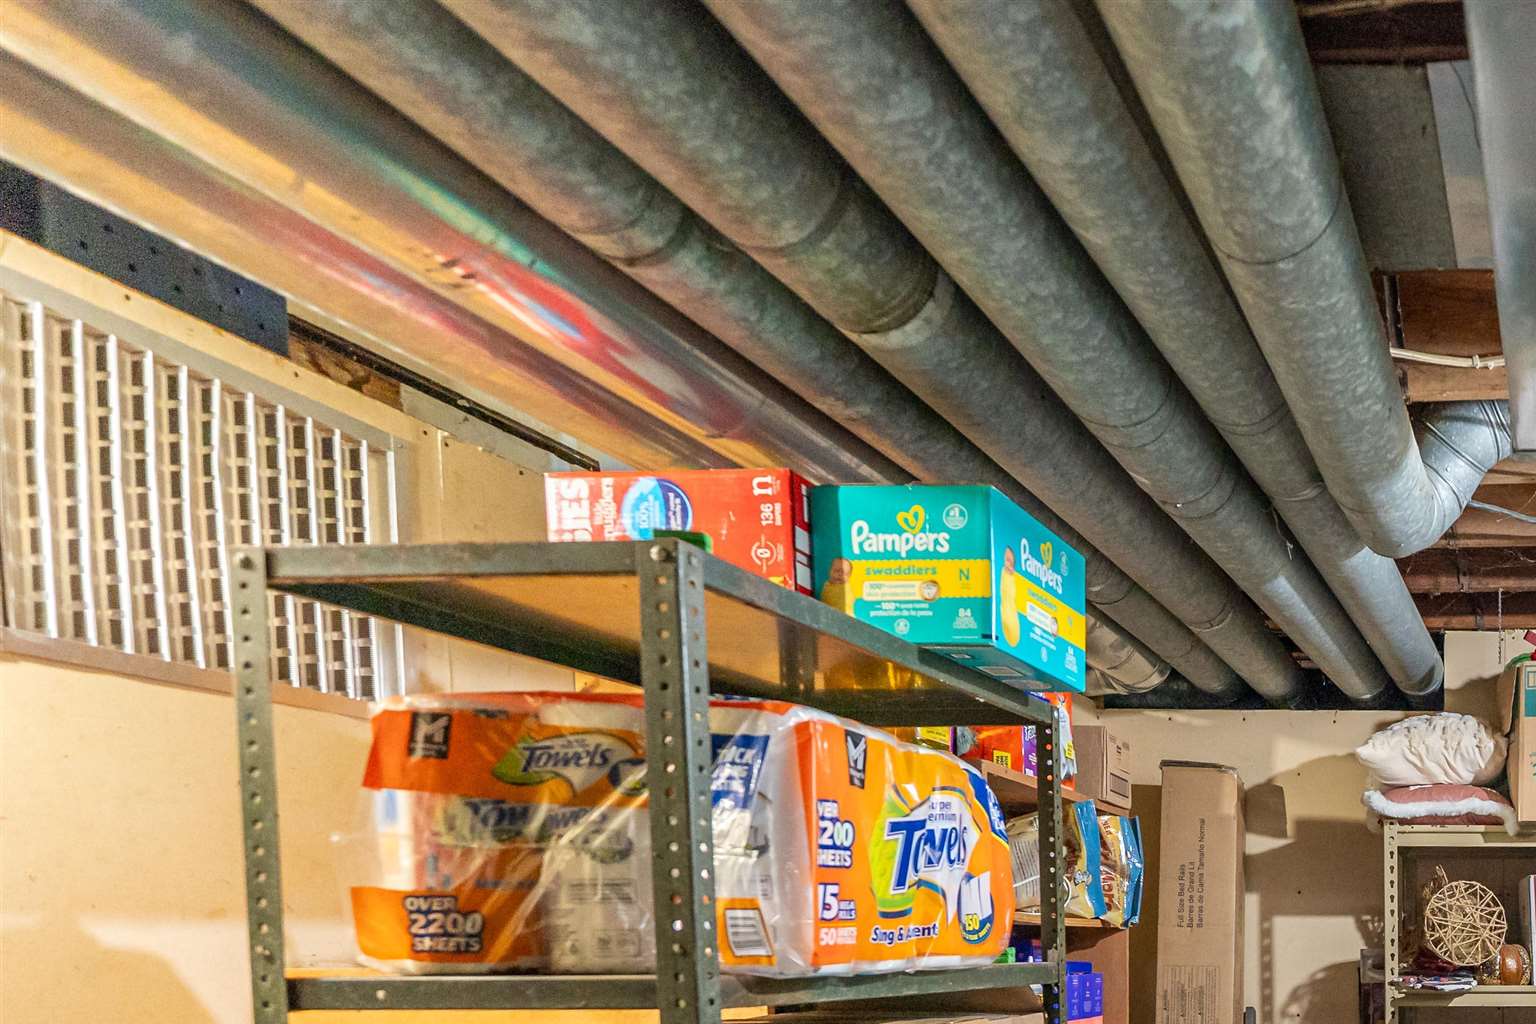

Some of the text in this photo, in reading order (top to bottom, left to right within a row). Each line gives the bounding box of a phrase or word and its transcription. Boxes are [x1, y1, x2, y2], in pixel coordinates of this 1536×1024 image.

[760, 503, 773, 527] 136
[851, 520, 950, 558] Pampers
[865, 565, 937, 576] swaddlers
[958, 568, 971, 581] N
[1020, 538, 1063, 595] Pampers
[958, 608, 972, 617] 84
[520, 744, 614, 774] Towels
[817, 801, 838, 815] VER
[819, 821, 854, 847] 200
[1198, 818, 1206, 843] Normal
[817, 849, 852, 867] HEETS
[404, 896, 457, 912] OVER
[1177, 864, 1187, 928] Full Size Bed Rails
[1188, 895, 1195, 904] de
[1197, 895, 1204, 904] de
[409, 912, 484, 936] 2200
[413, 937, 481, 951] SHEETS
